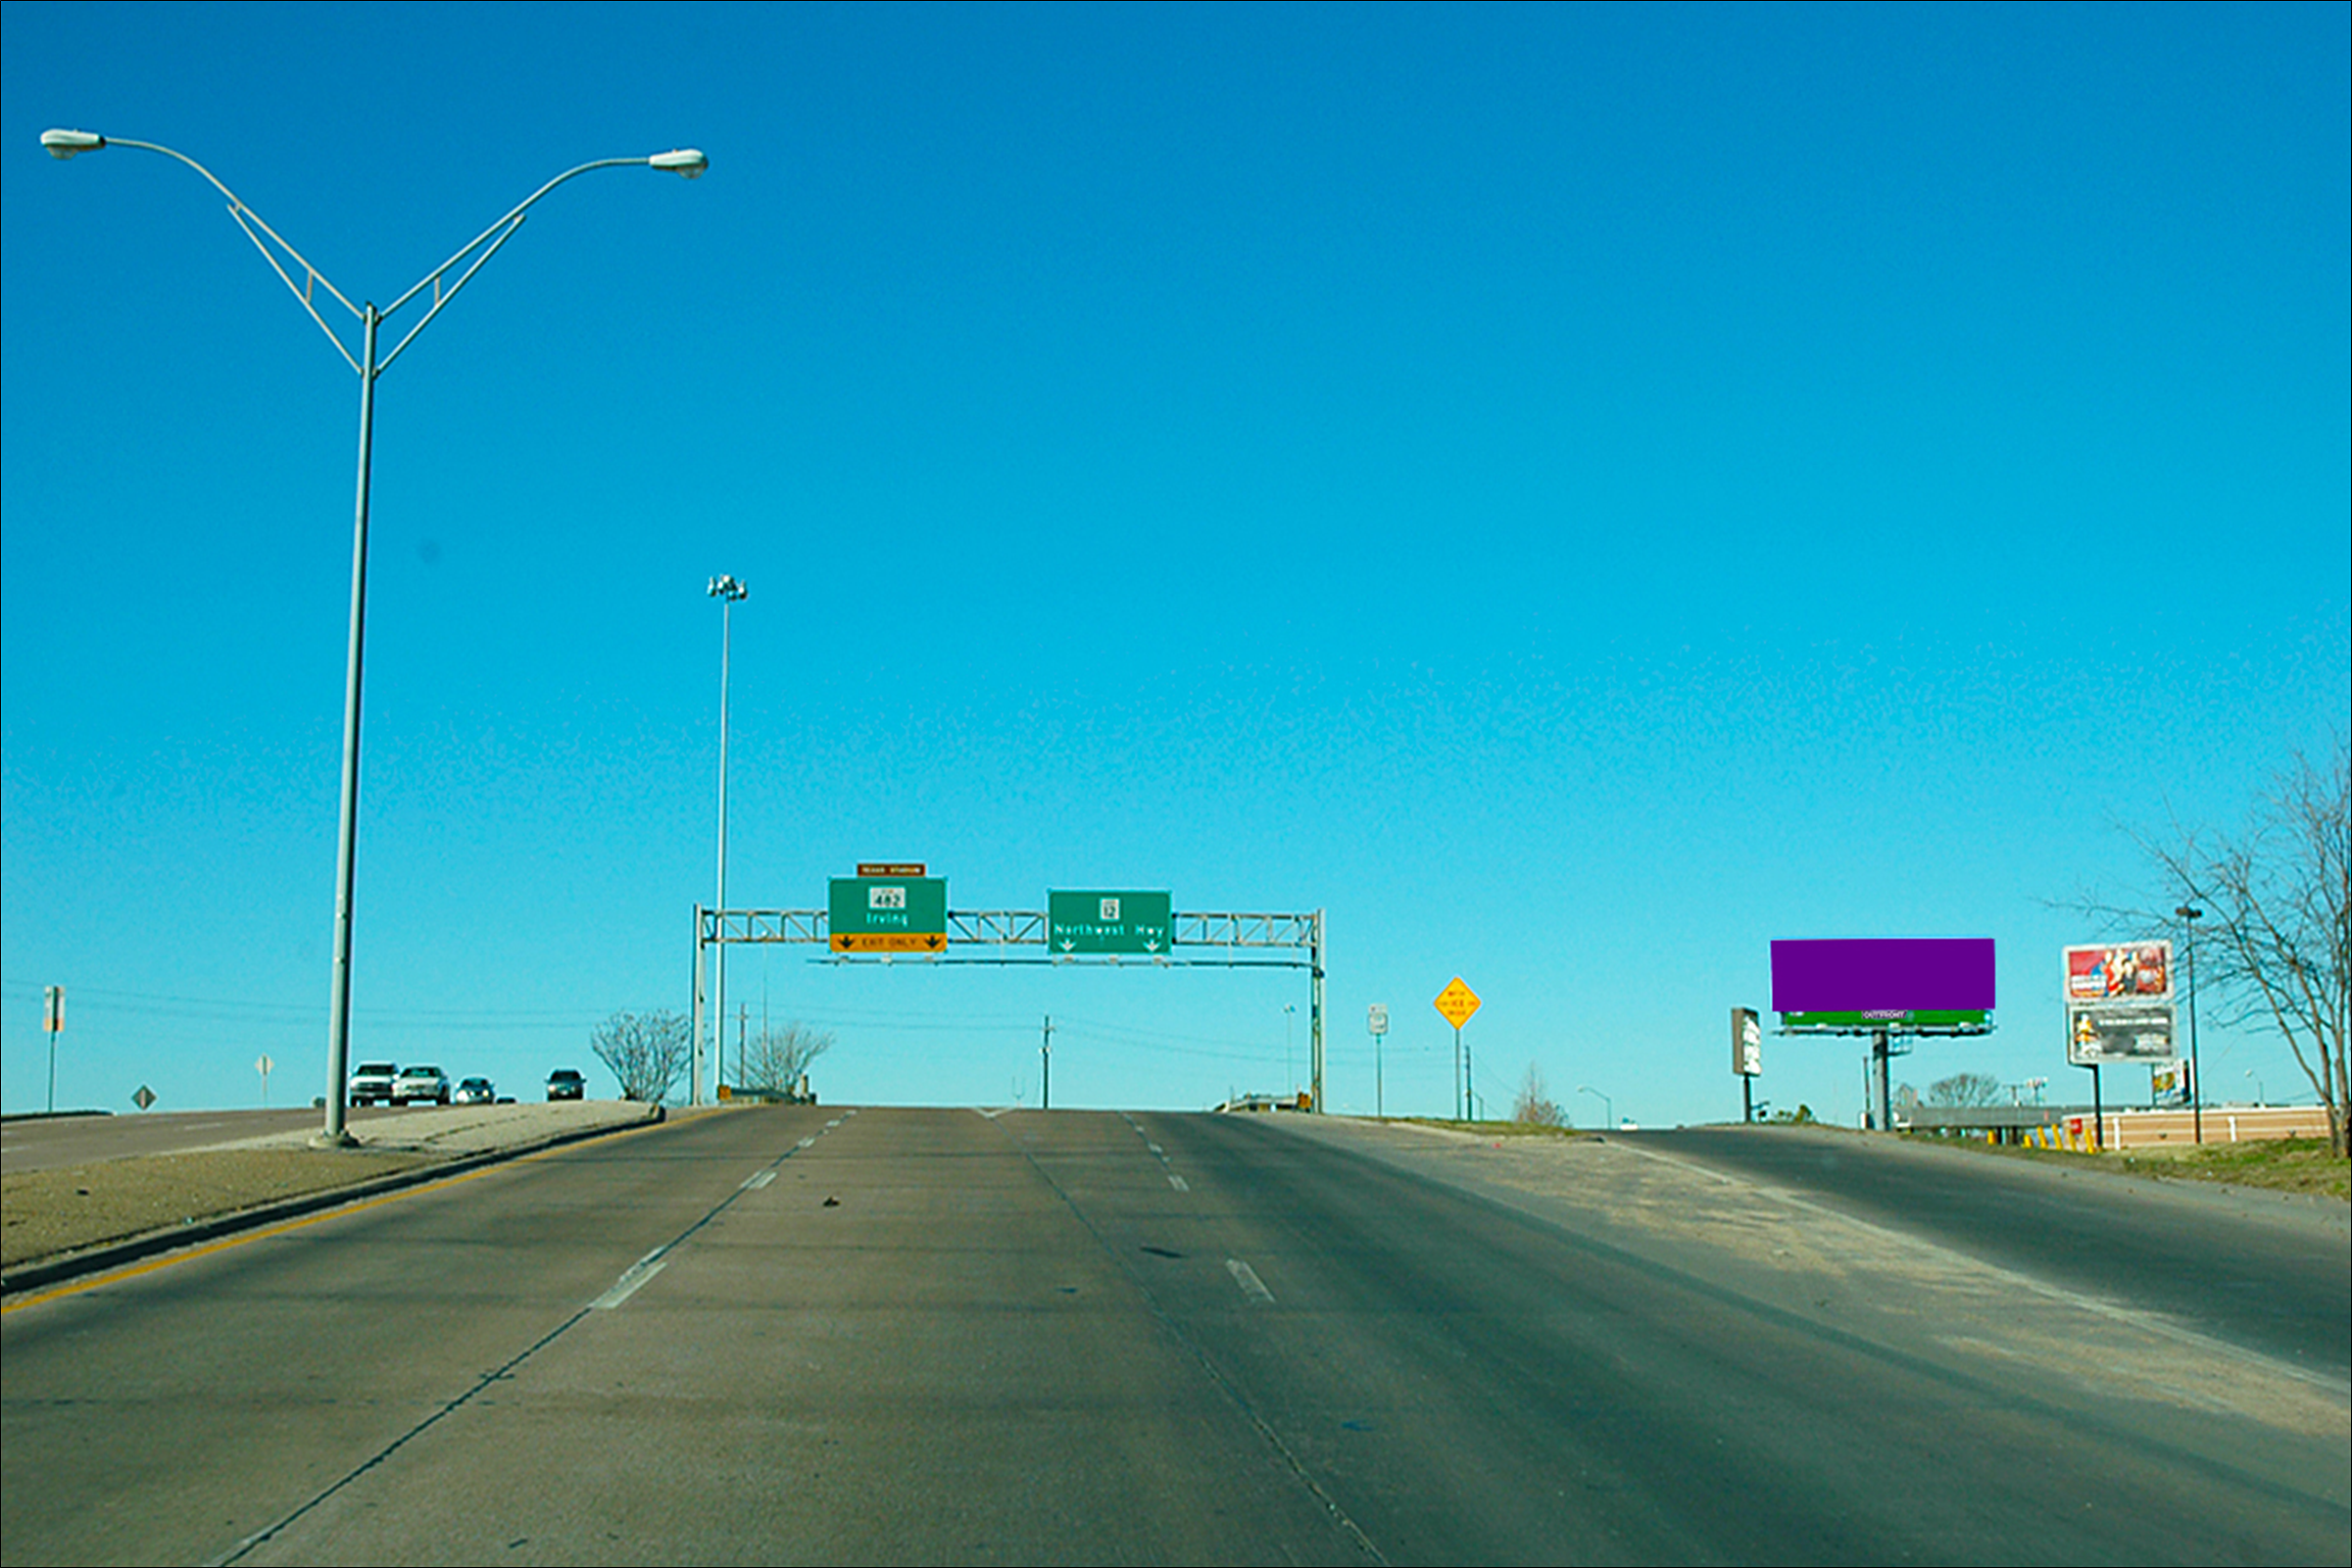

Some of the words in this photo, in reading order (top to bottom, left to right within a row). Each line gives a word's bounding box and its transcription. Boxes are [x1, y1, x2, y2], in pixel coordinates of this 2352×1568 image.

[874, 894, 902, 907] 482
[1102, 906, 1117, 918] 12
[866, 912, 907, 927] Irving
[1054, 923, 1125, 936] Northwest
[1135, 923, 1164, 939] Hwy
[861, 937, 885, 947] EXIT
[888, 937, 917, 947] ONLY
